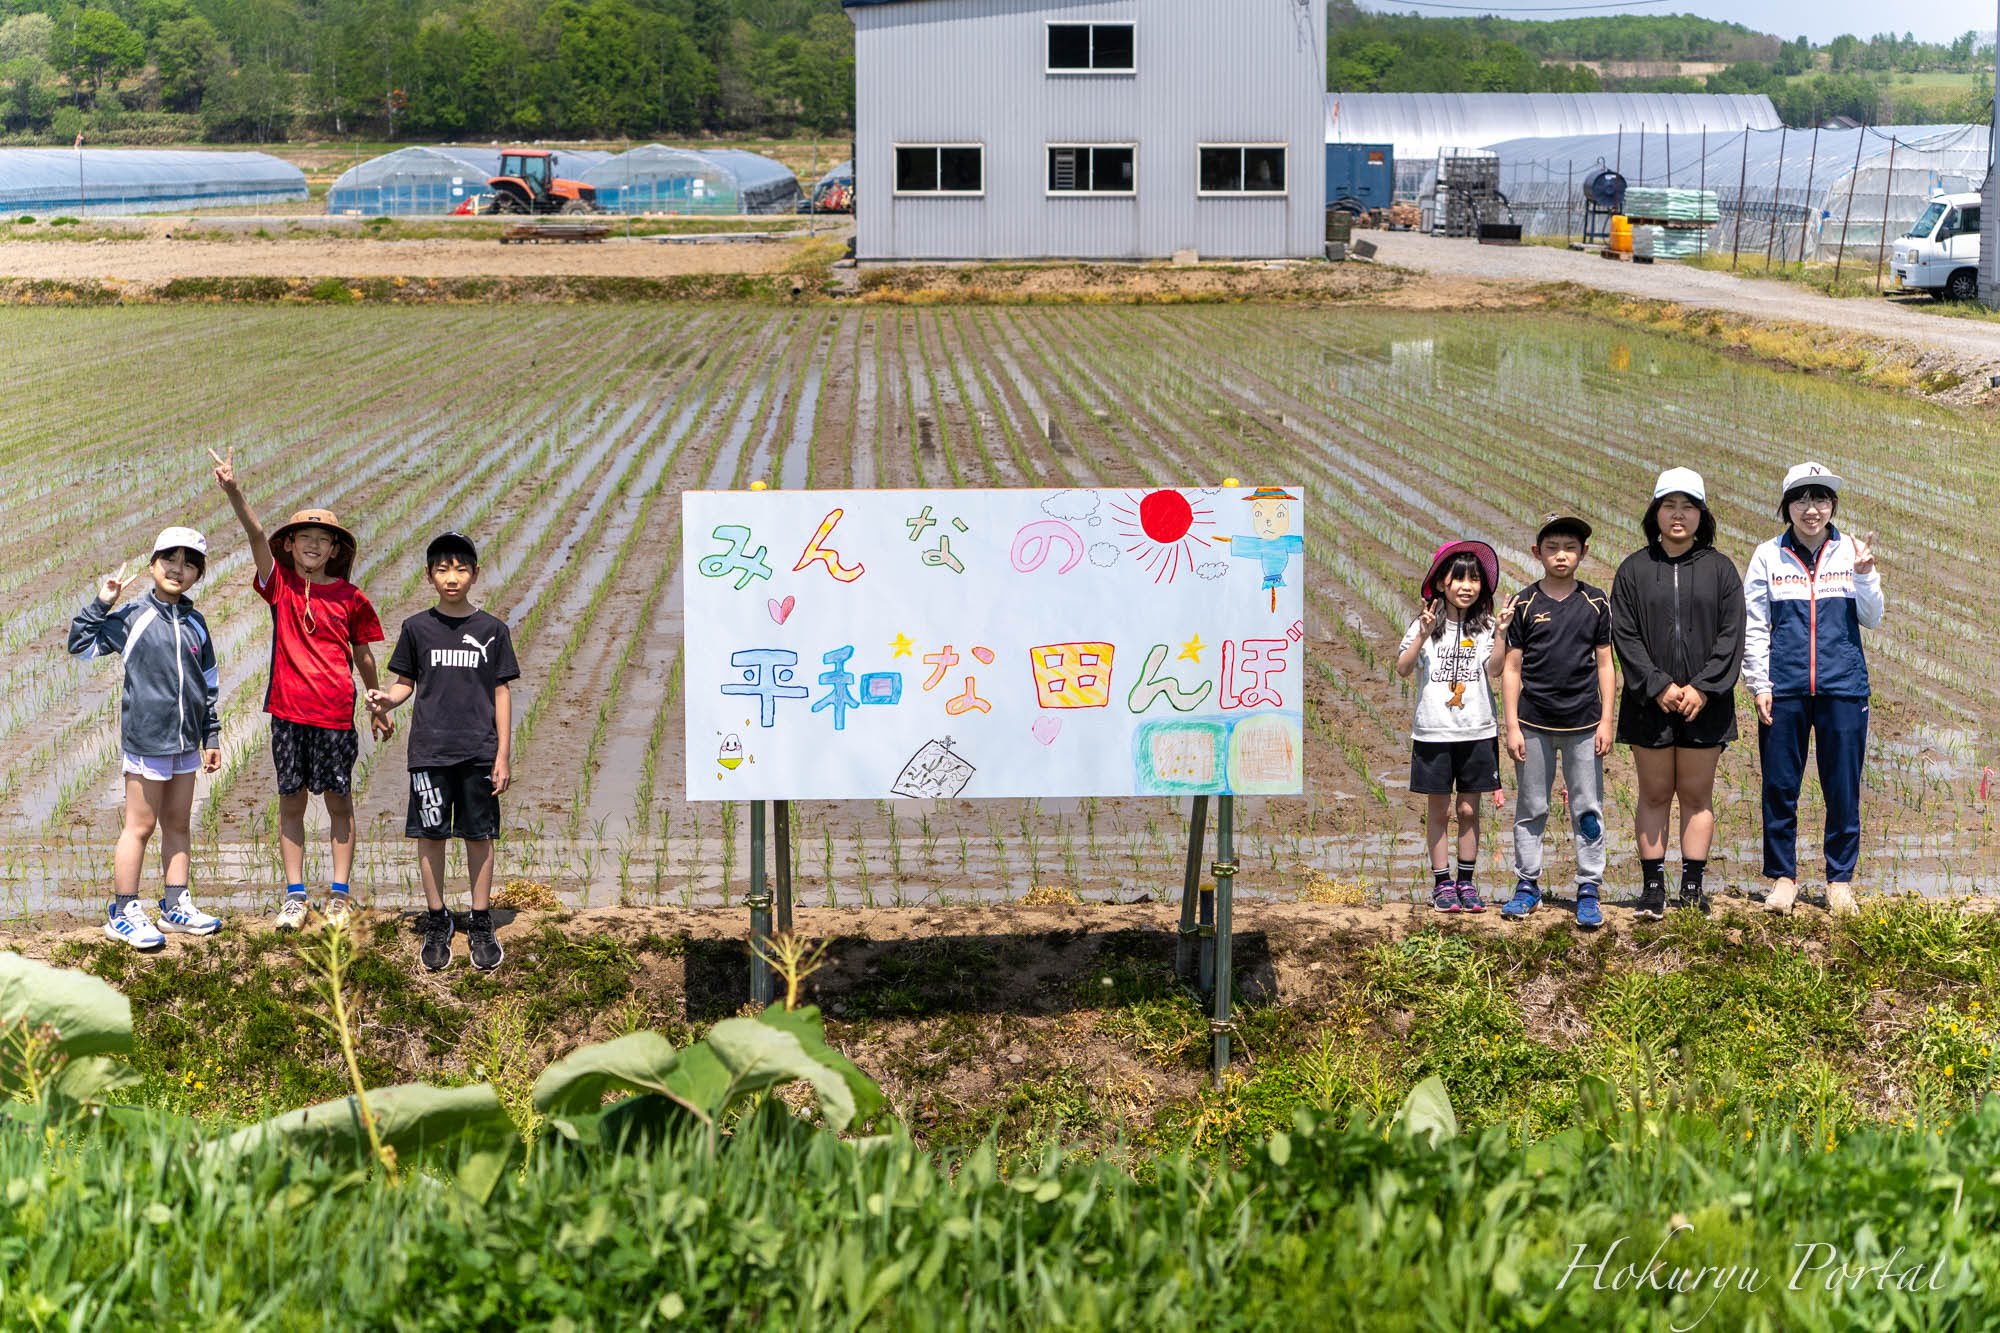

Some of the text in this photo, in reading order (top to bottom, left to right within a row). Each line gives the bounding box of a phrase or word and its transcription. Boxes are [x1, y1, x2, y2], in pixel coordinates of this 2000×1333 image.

[1809, 466, 1821, 476] N
[699, 505, 1084, 590] みんなの
[1771, 568, 1854, 588] le coq sporti
[431, 649, 480, 669] PUMA
[1437, 646, 1477, 659] WHERE
[1440, 658, 1473, 671] IS MY
[1431, 668, 1482, 683] CHEESE?
[412, 771, 432, 792] MI
[419, 787, 443, 809] ZU
[419, 807, 443, 828] NO
